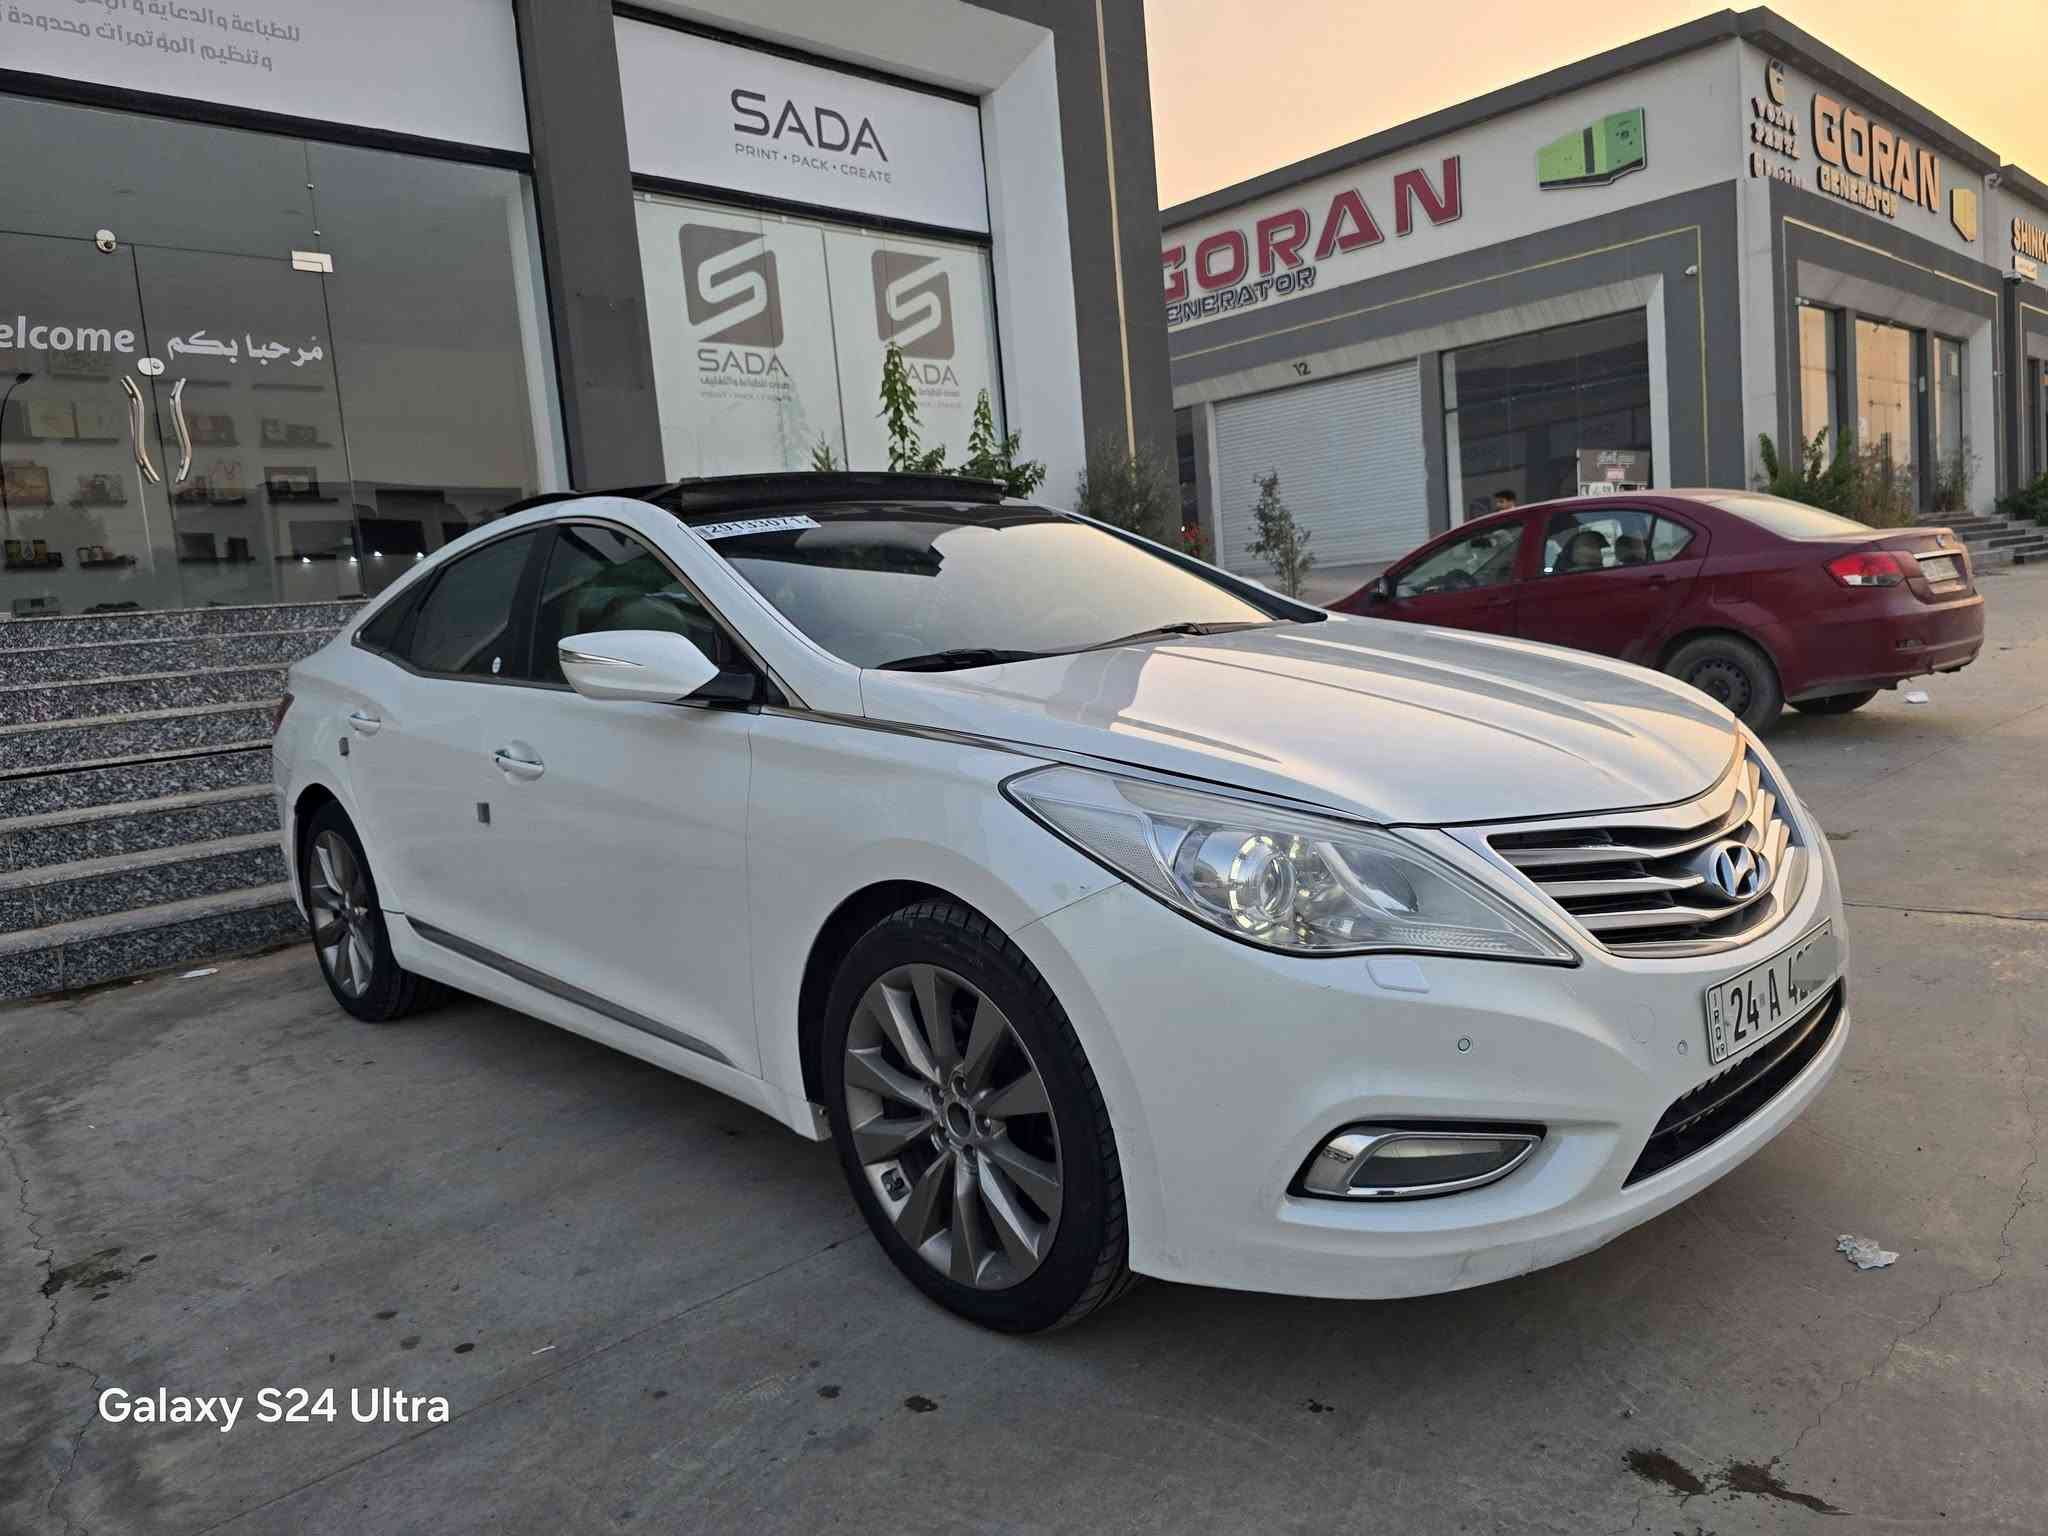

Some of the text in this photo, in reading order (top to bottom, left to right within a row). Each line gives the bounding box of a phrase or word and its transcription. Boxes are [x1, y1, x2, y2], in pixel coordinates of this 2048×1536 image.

[731, 88, 888, 162] SADA
[734, 143, 893, 184] PRINT PACK CREATE
[1811, 92, 1942, 213] GORAN
[2012, 216, 2048, 264] SHINK
[1166, 265, 1317, 326] ENERATOR
[0, 315, 135, 352] elcome
[167, 330, 238, 364] بكم
[697, 348, 789, 378] SADA
[905, 362, 960, 387] ADA
[1292, 361, 1312, 377] 12
[1730, 980, 1760, 1043] 24
[1768, 967, 1782, 1022] A
